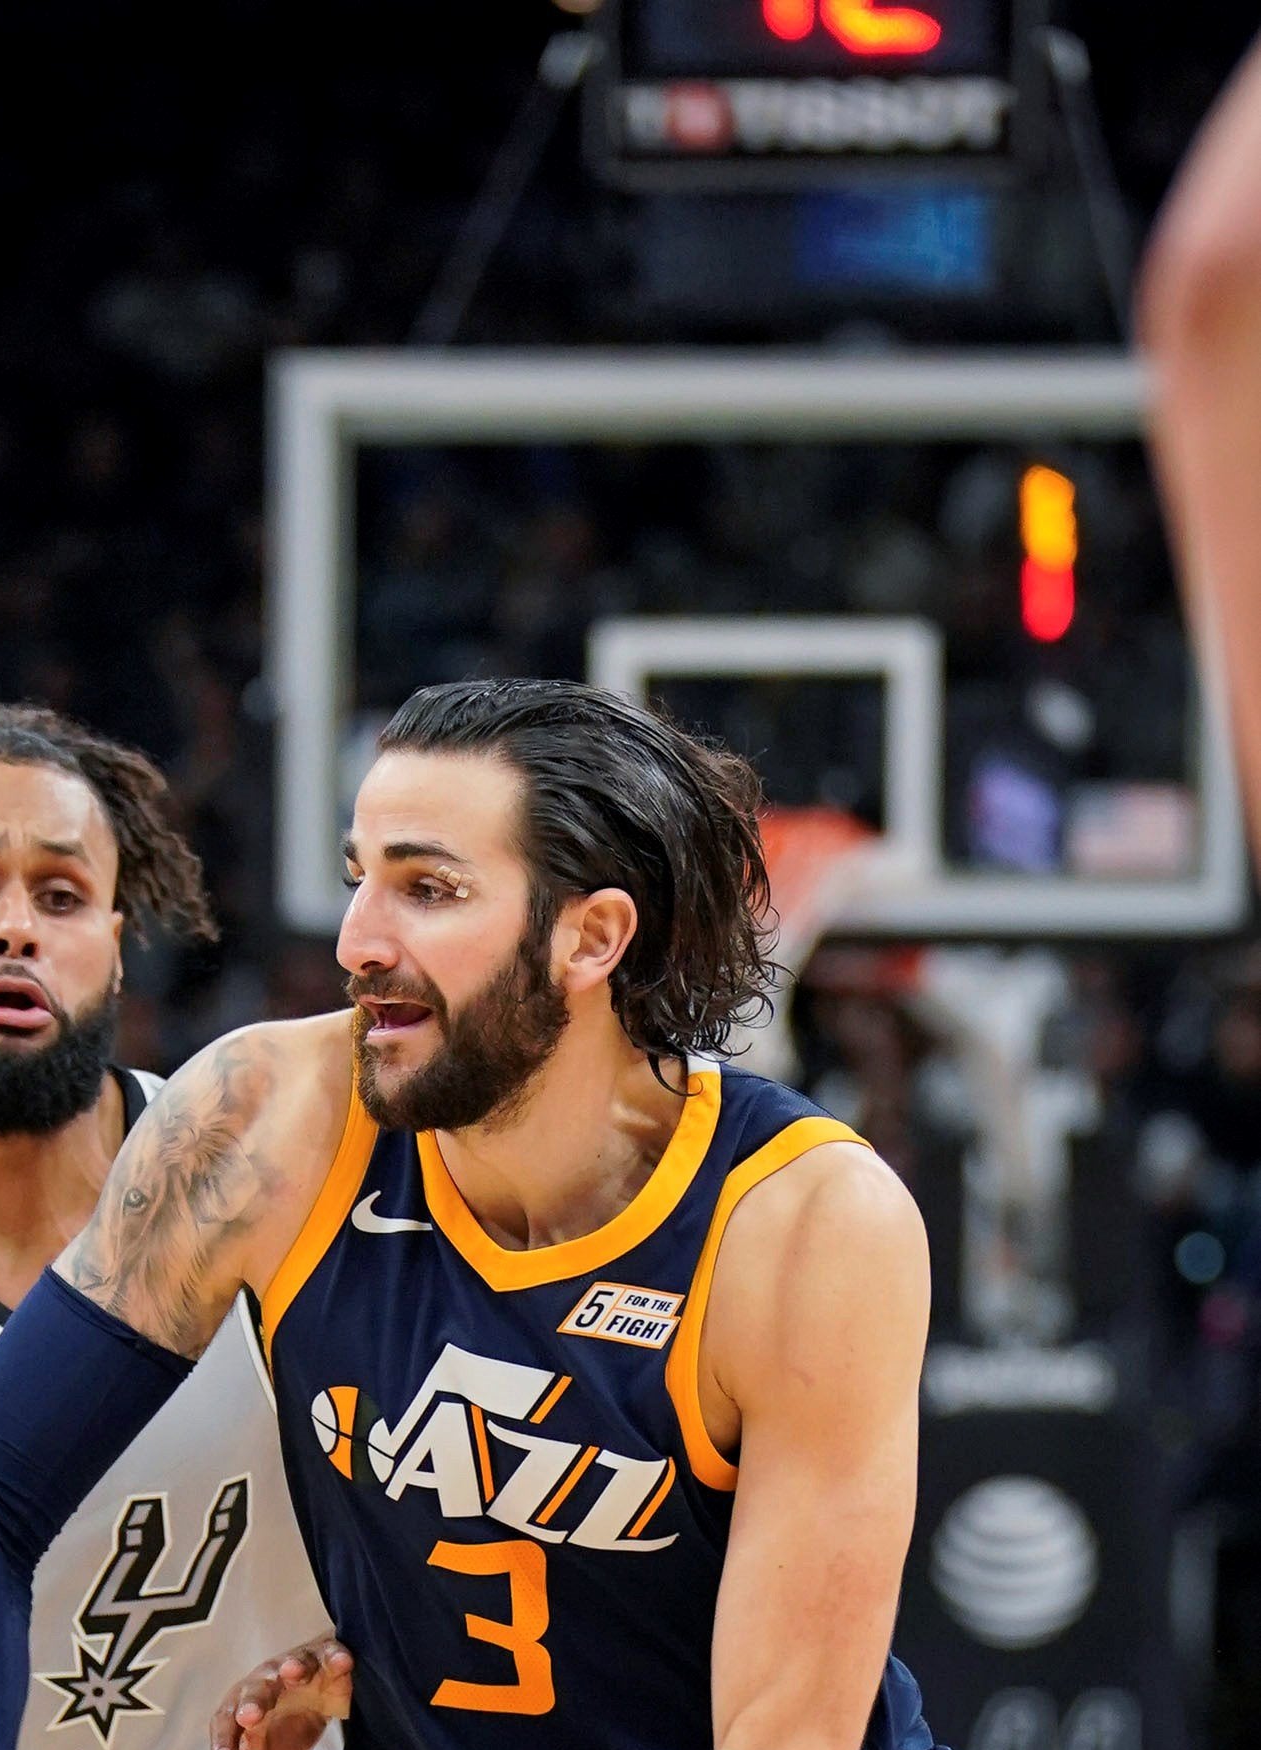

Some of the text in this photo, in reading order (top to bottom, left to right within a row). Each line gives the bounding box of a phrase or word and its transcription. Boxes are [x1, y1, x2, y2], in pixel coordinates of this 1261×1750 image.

[575, 1290, 615, 1328] 5
[624, 1294, 674, 1313] FOR THE
[605, 1315, 670, 1341] FIGHT
[311, 1342, 680, 1552] JAZZ
[426, 1539, 556, 1716] 3
